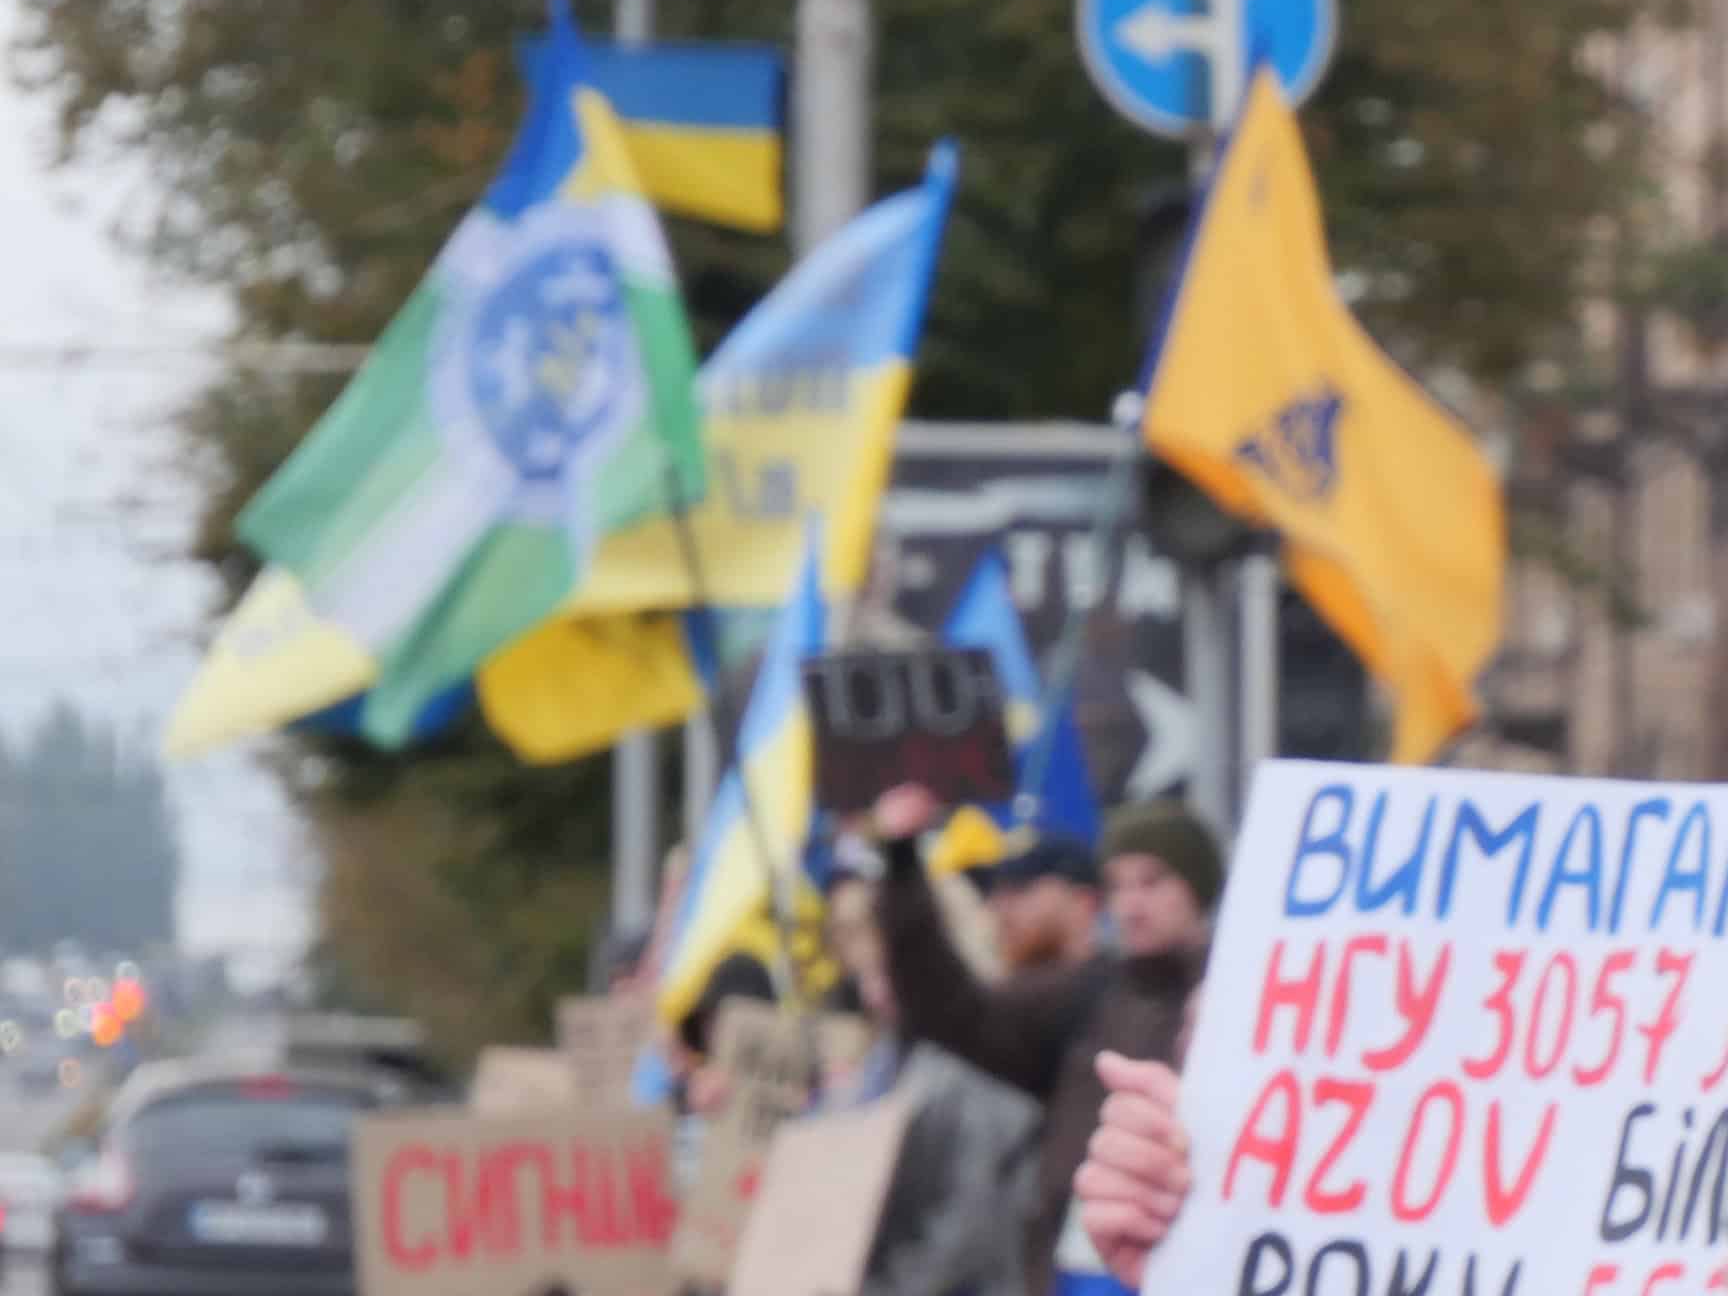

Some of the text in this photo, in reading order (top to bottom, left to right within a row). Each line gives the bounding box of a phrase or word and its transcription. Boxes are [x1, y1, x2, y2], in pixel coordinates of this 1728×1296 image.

[1252, 935, 1452, 1072] НГУ
[1462, 949, 1694, 1086] 3057
[1222, 1071, 1556, 1226] AZOV
